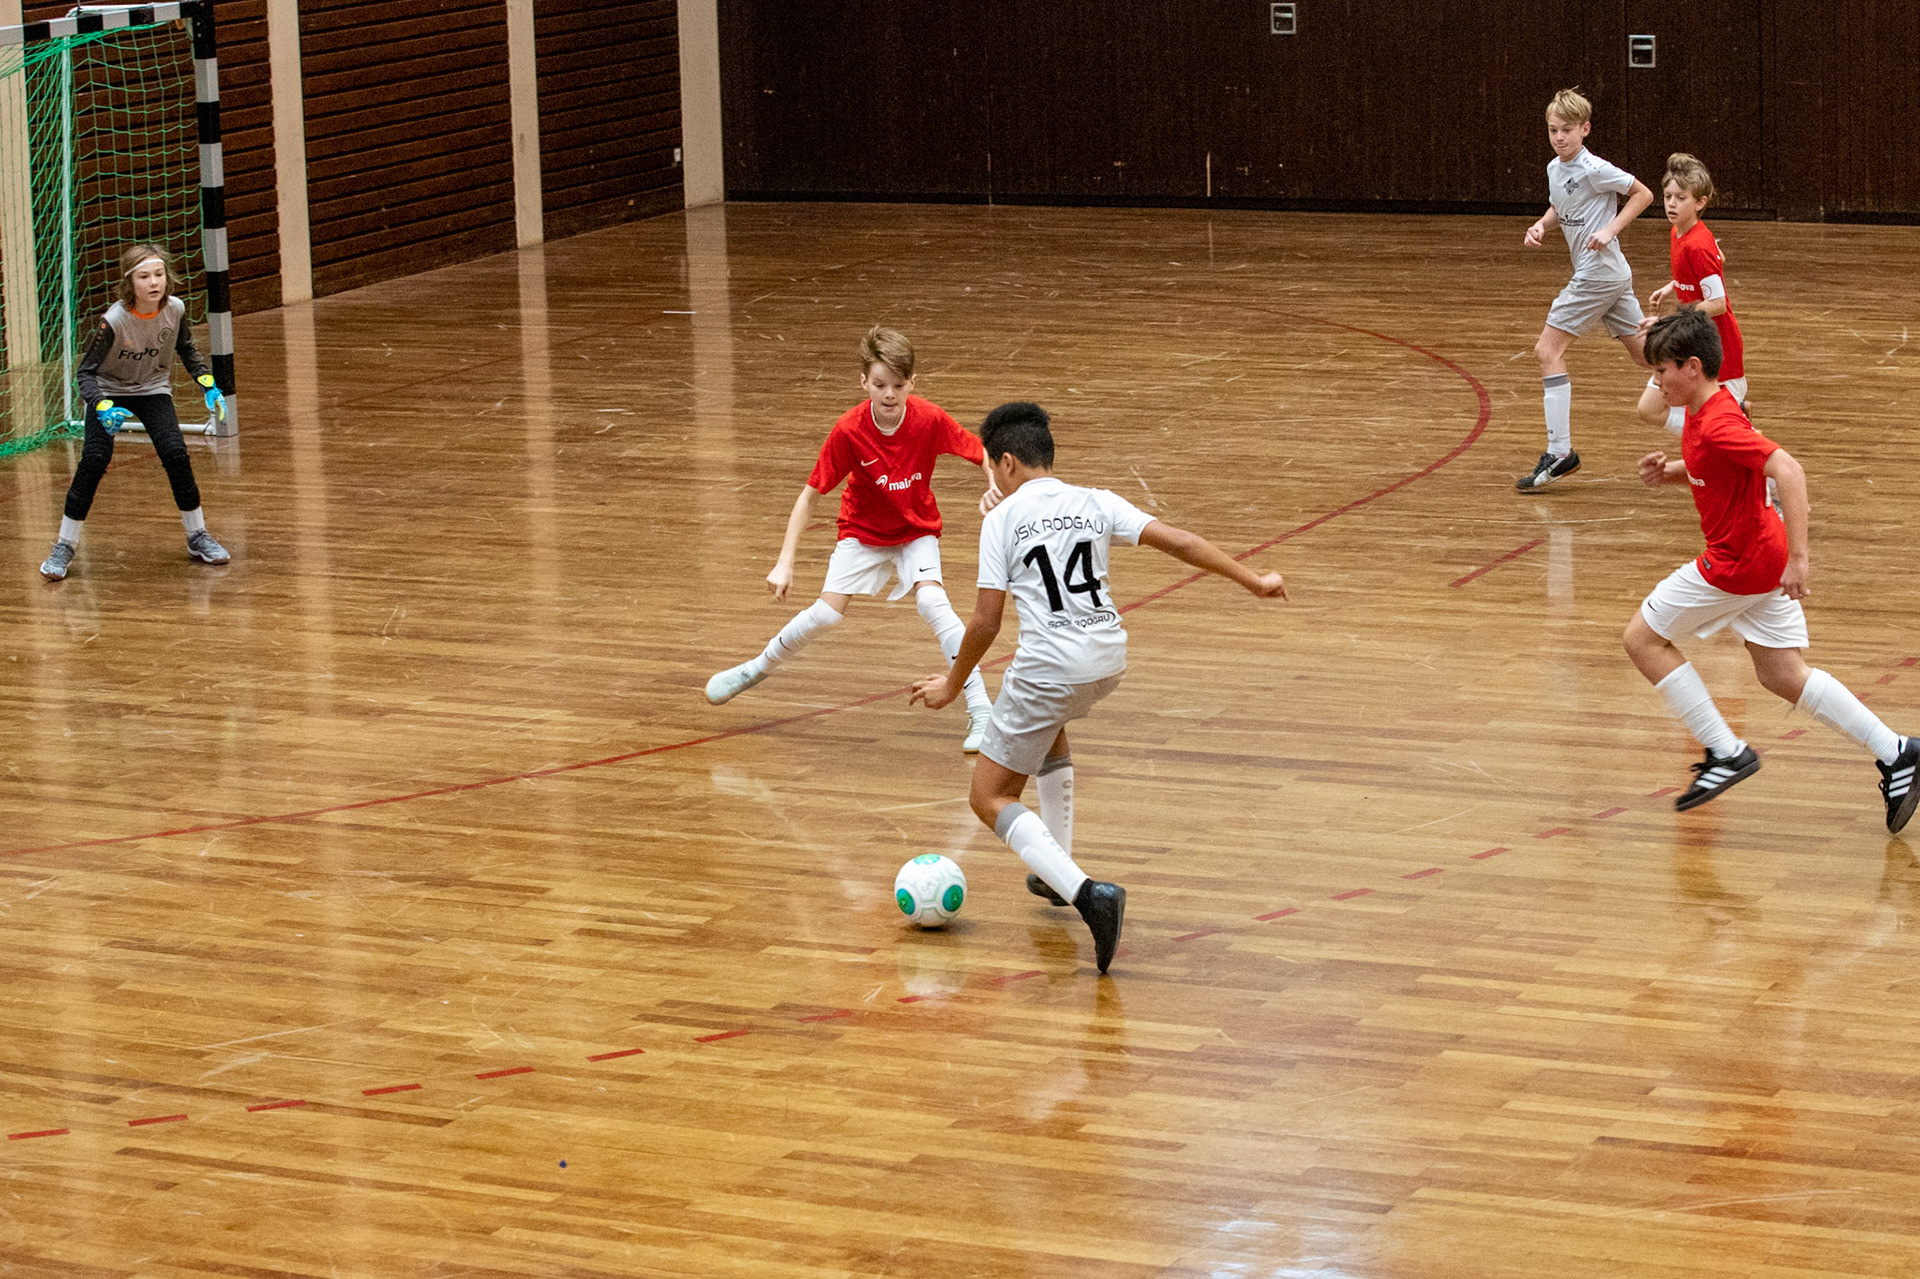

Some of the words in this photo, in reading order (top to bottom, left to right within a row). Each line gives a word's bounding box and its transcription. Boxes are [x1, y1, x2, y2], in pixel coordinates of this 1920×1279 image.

[1014, 521, 1040, 546] JSK
[1042, 516, 1104, 534] RODGAU
[1023, 541, 1103, 612] 14
